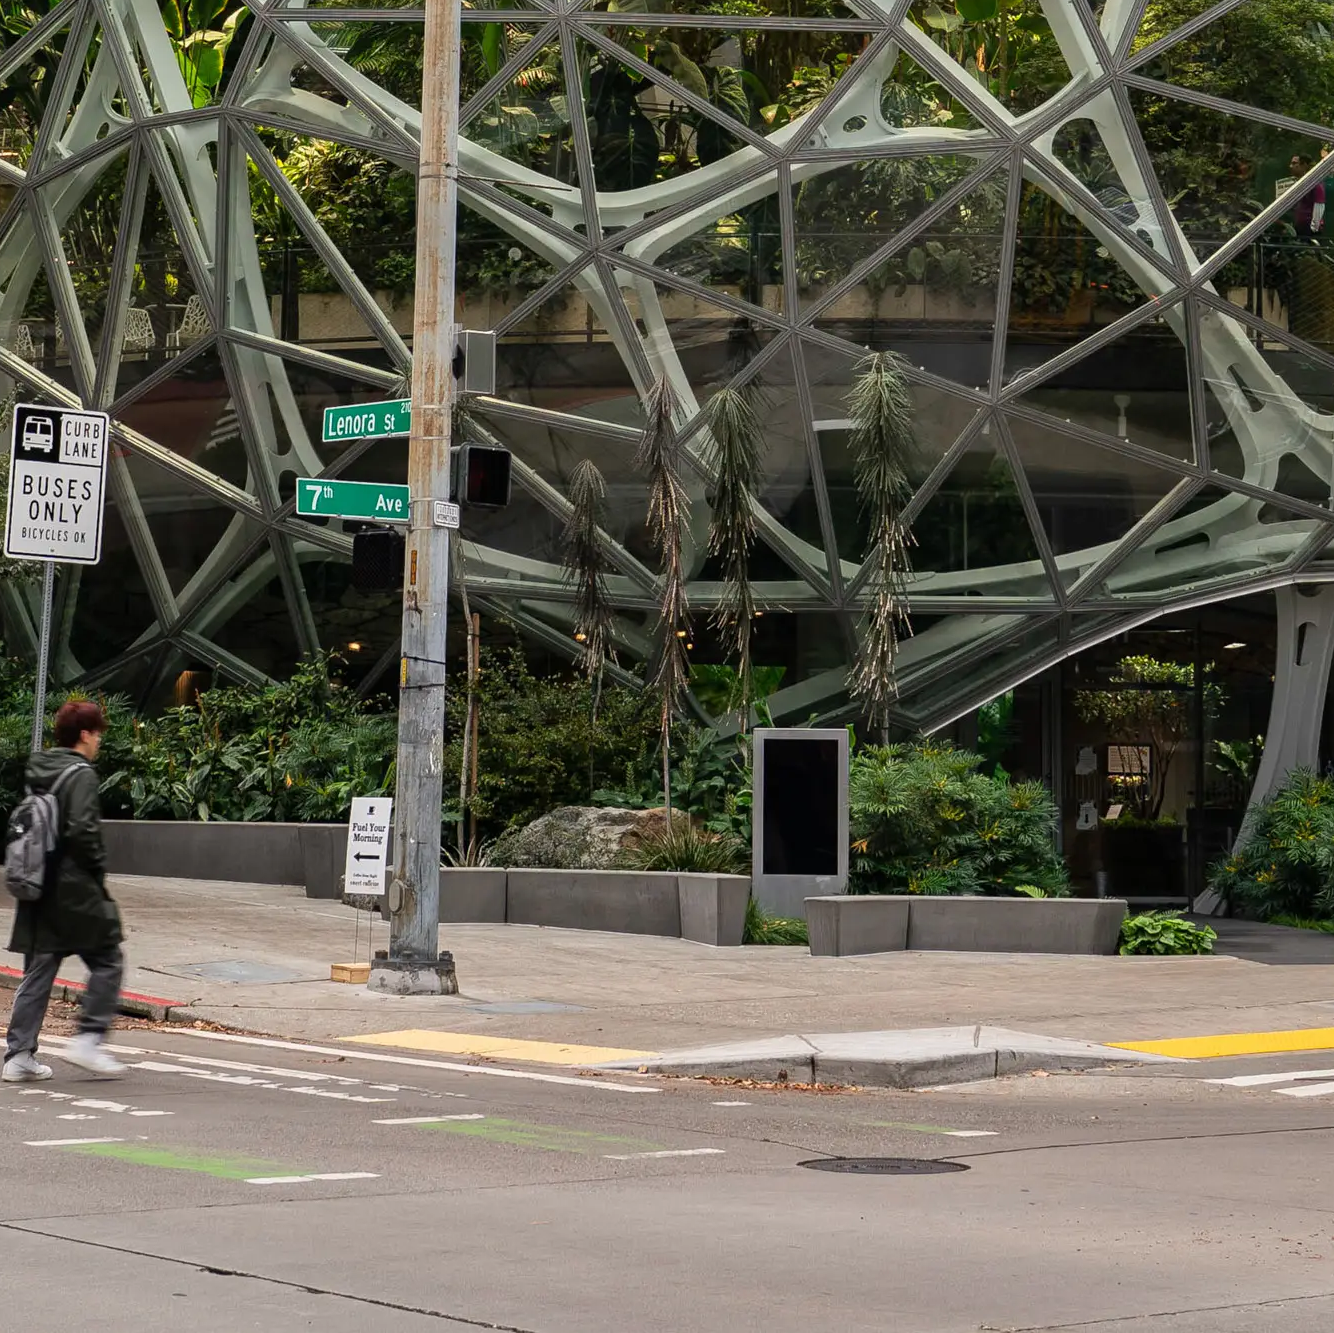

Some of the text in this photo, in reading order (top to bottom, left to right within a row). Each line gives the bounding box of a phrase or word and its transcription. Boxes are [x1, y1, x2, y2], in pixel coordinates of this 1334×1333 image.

[65, 420, 100, 439] CURB
[328, 411, 395, 437] Lenora St
[65, 440, 98, 459] LANE
[23, 474, 92, 501] BUSES
[305, 484, 403, 512] 7th Ave
[29, 499, 83, 524] ONLY
[21, 526, 86, 544] BICYCLES OK
[352, 822, 386, 833] Fuel Your
[352, 833, 383, 845] Morning
